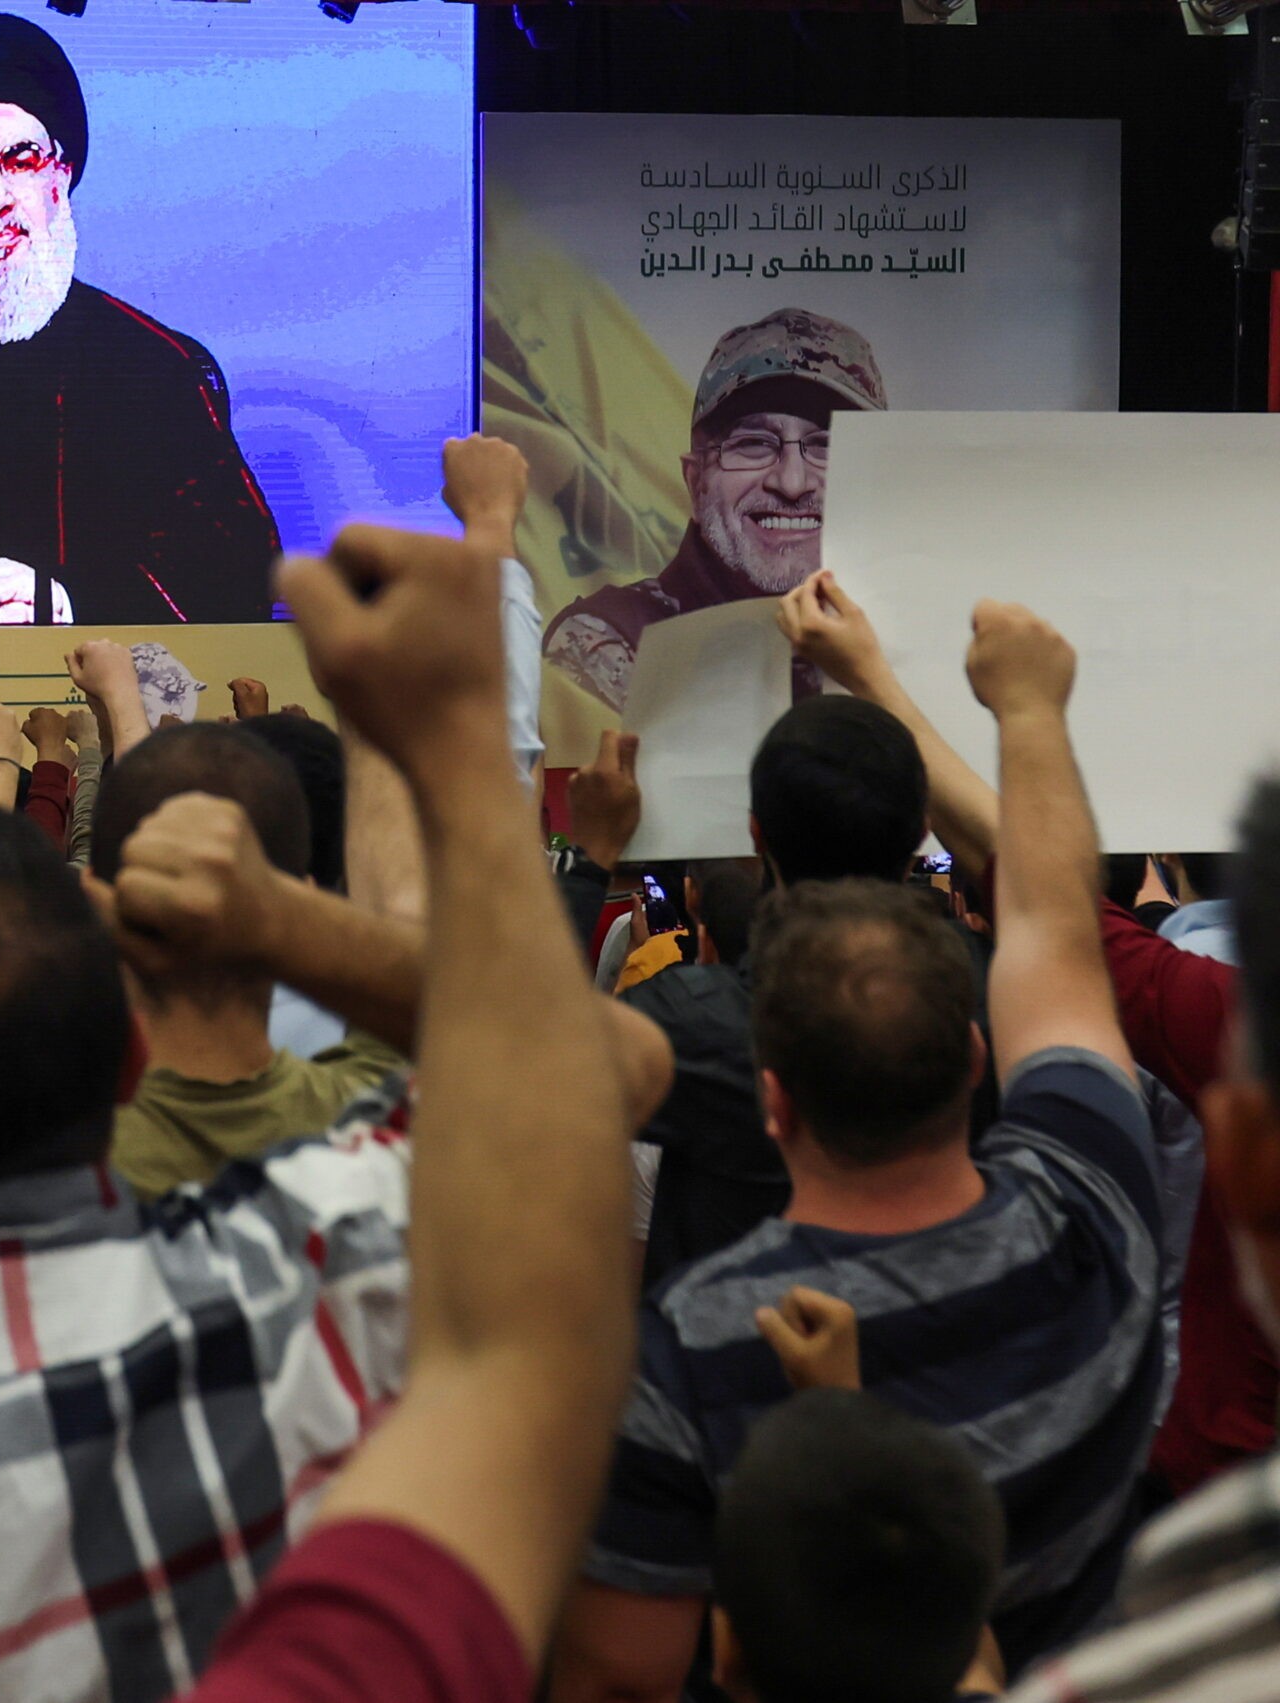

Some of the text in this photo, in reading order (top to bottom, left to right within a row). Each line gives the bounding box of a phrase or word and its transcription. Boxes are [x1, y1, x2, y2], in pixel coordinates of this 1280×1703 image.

[640, 162, 967, 196] الذكرى السنوية السادسة
[640, 202, 967, 243] لاستشهاد القائد الجهادي
[640, 246, 705, 277] الدين
[711, 252, 753, 277] بدر
[761, 246, 873, 278] مصطفى
